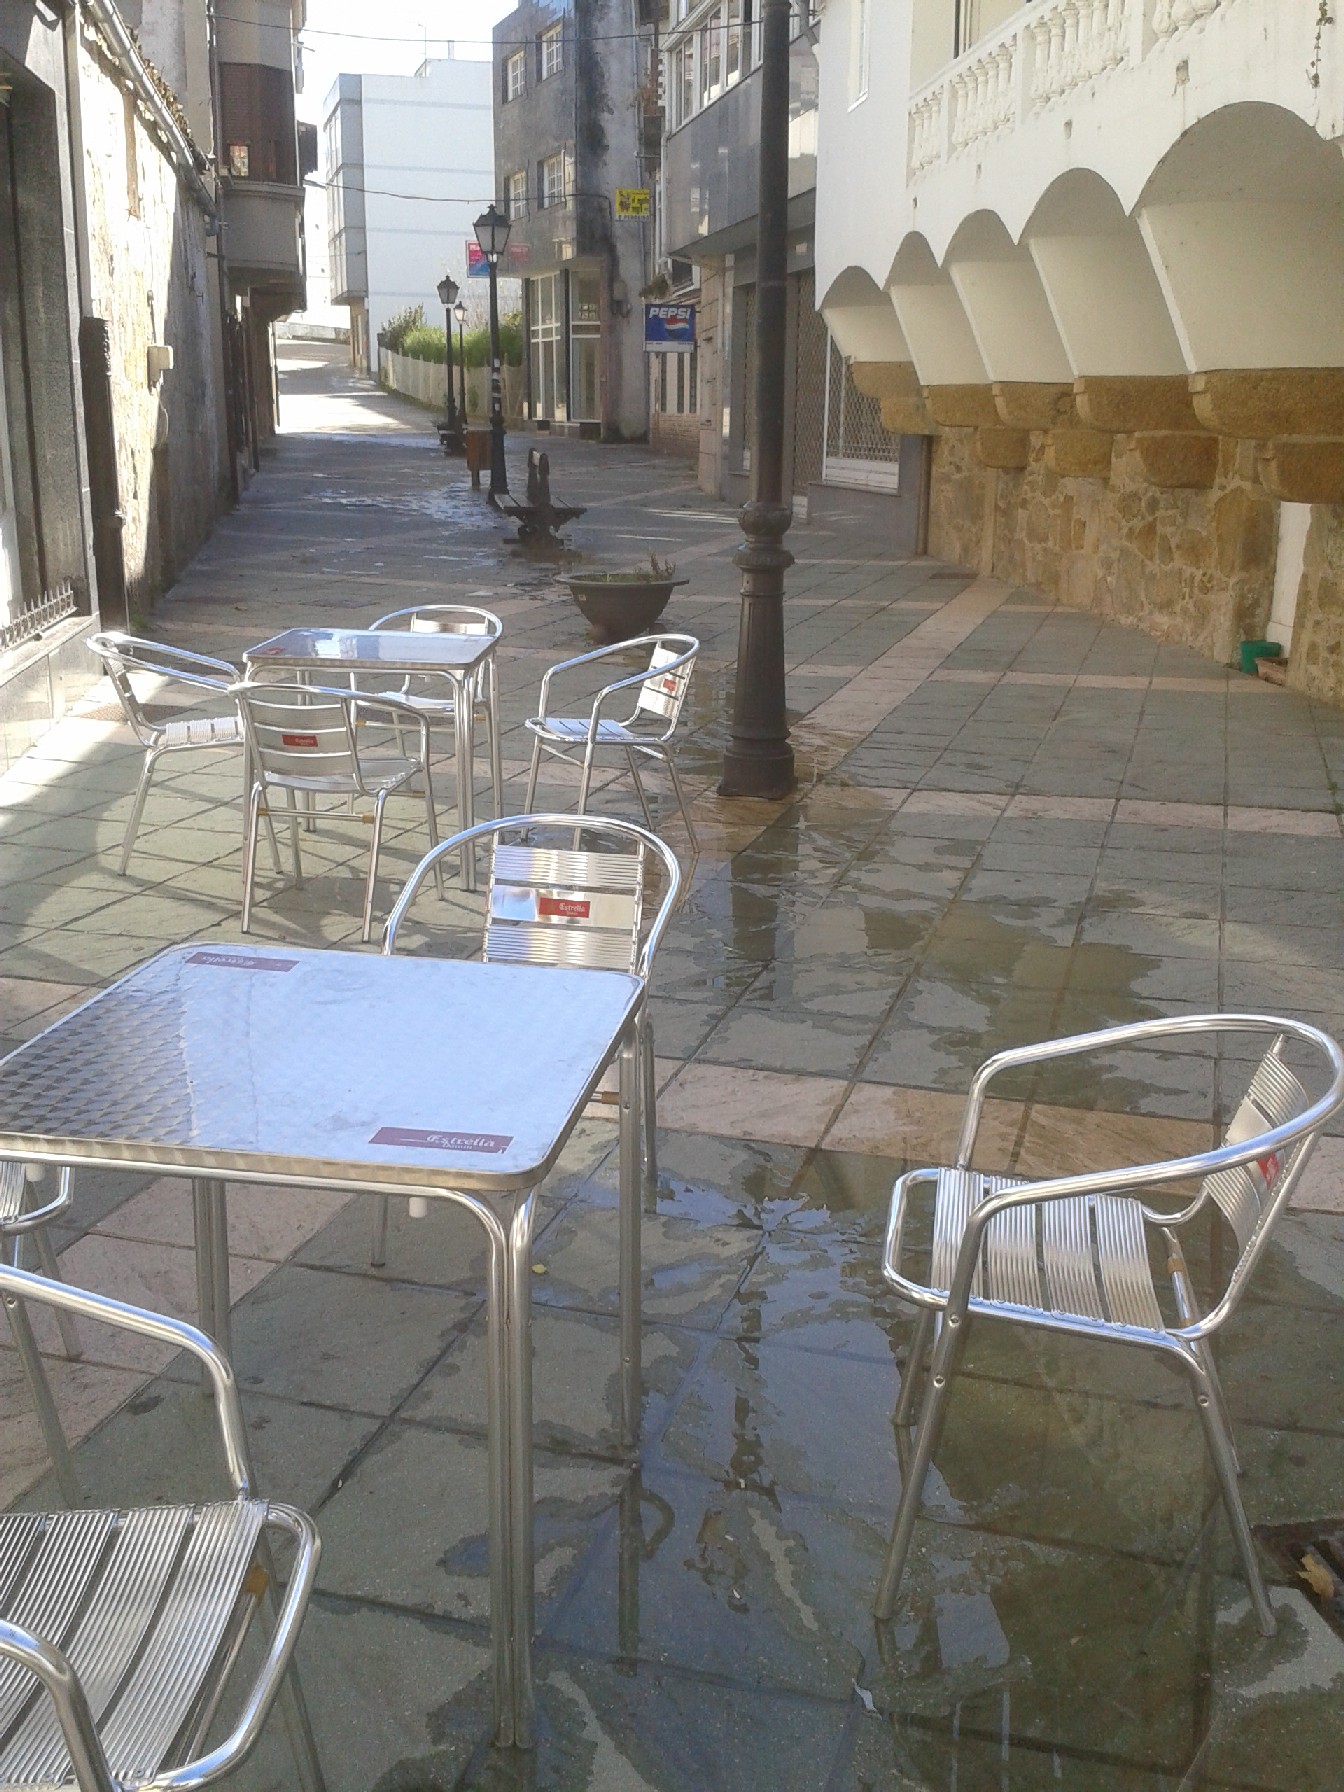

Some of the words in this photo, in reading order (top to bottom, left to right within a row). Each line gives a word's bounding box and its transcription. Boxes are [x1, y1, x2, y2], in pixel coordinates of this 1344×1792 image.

[649, 307, 691, 319] PEPSI
[559, 902, 586, 913] Estrella
[426, 1134, 496, 1147] Estrella
